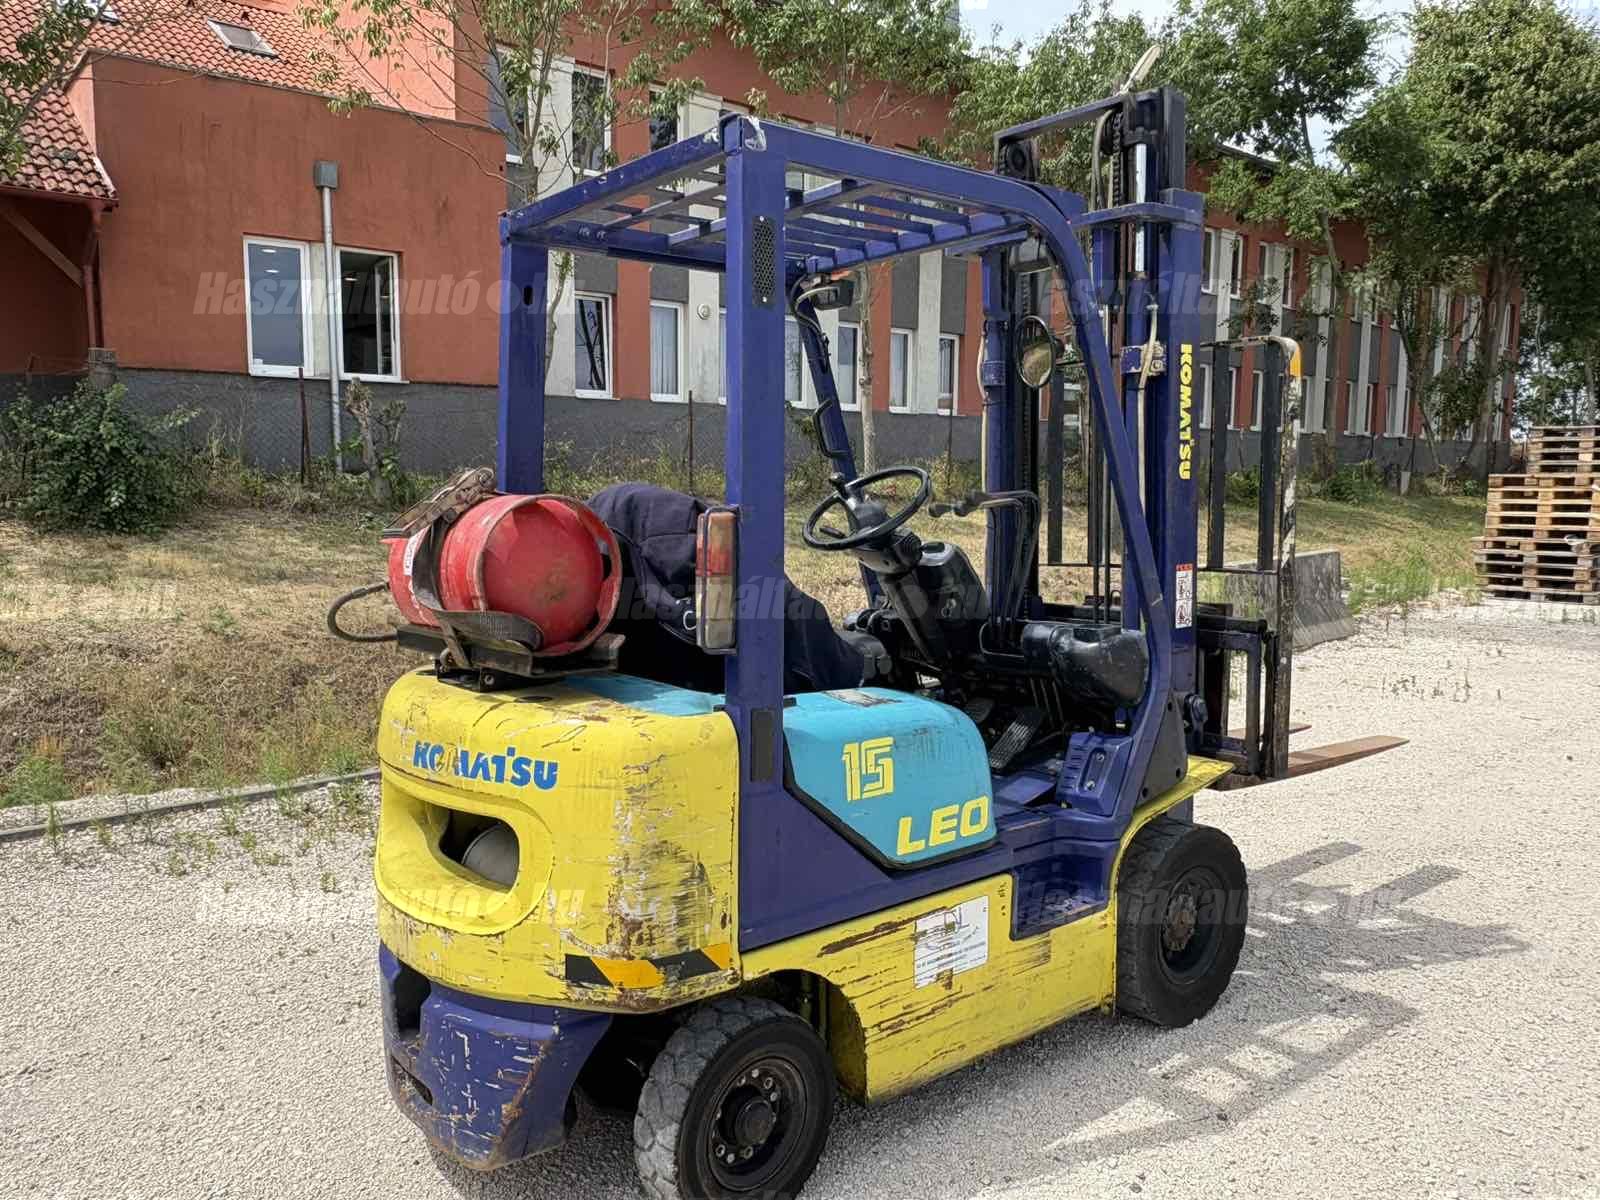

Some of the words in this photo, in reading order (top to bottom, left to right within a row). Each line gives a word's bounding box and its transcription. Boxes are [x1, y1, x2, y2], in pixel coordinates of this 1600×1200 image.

[1179, 344, 1195, 480] KOMATSU
[842, 736, 894, 802] 15
[896, 795, 990, 856] LEO
